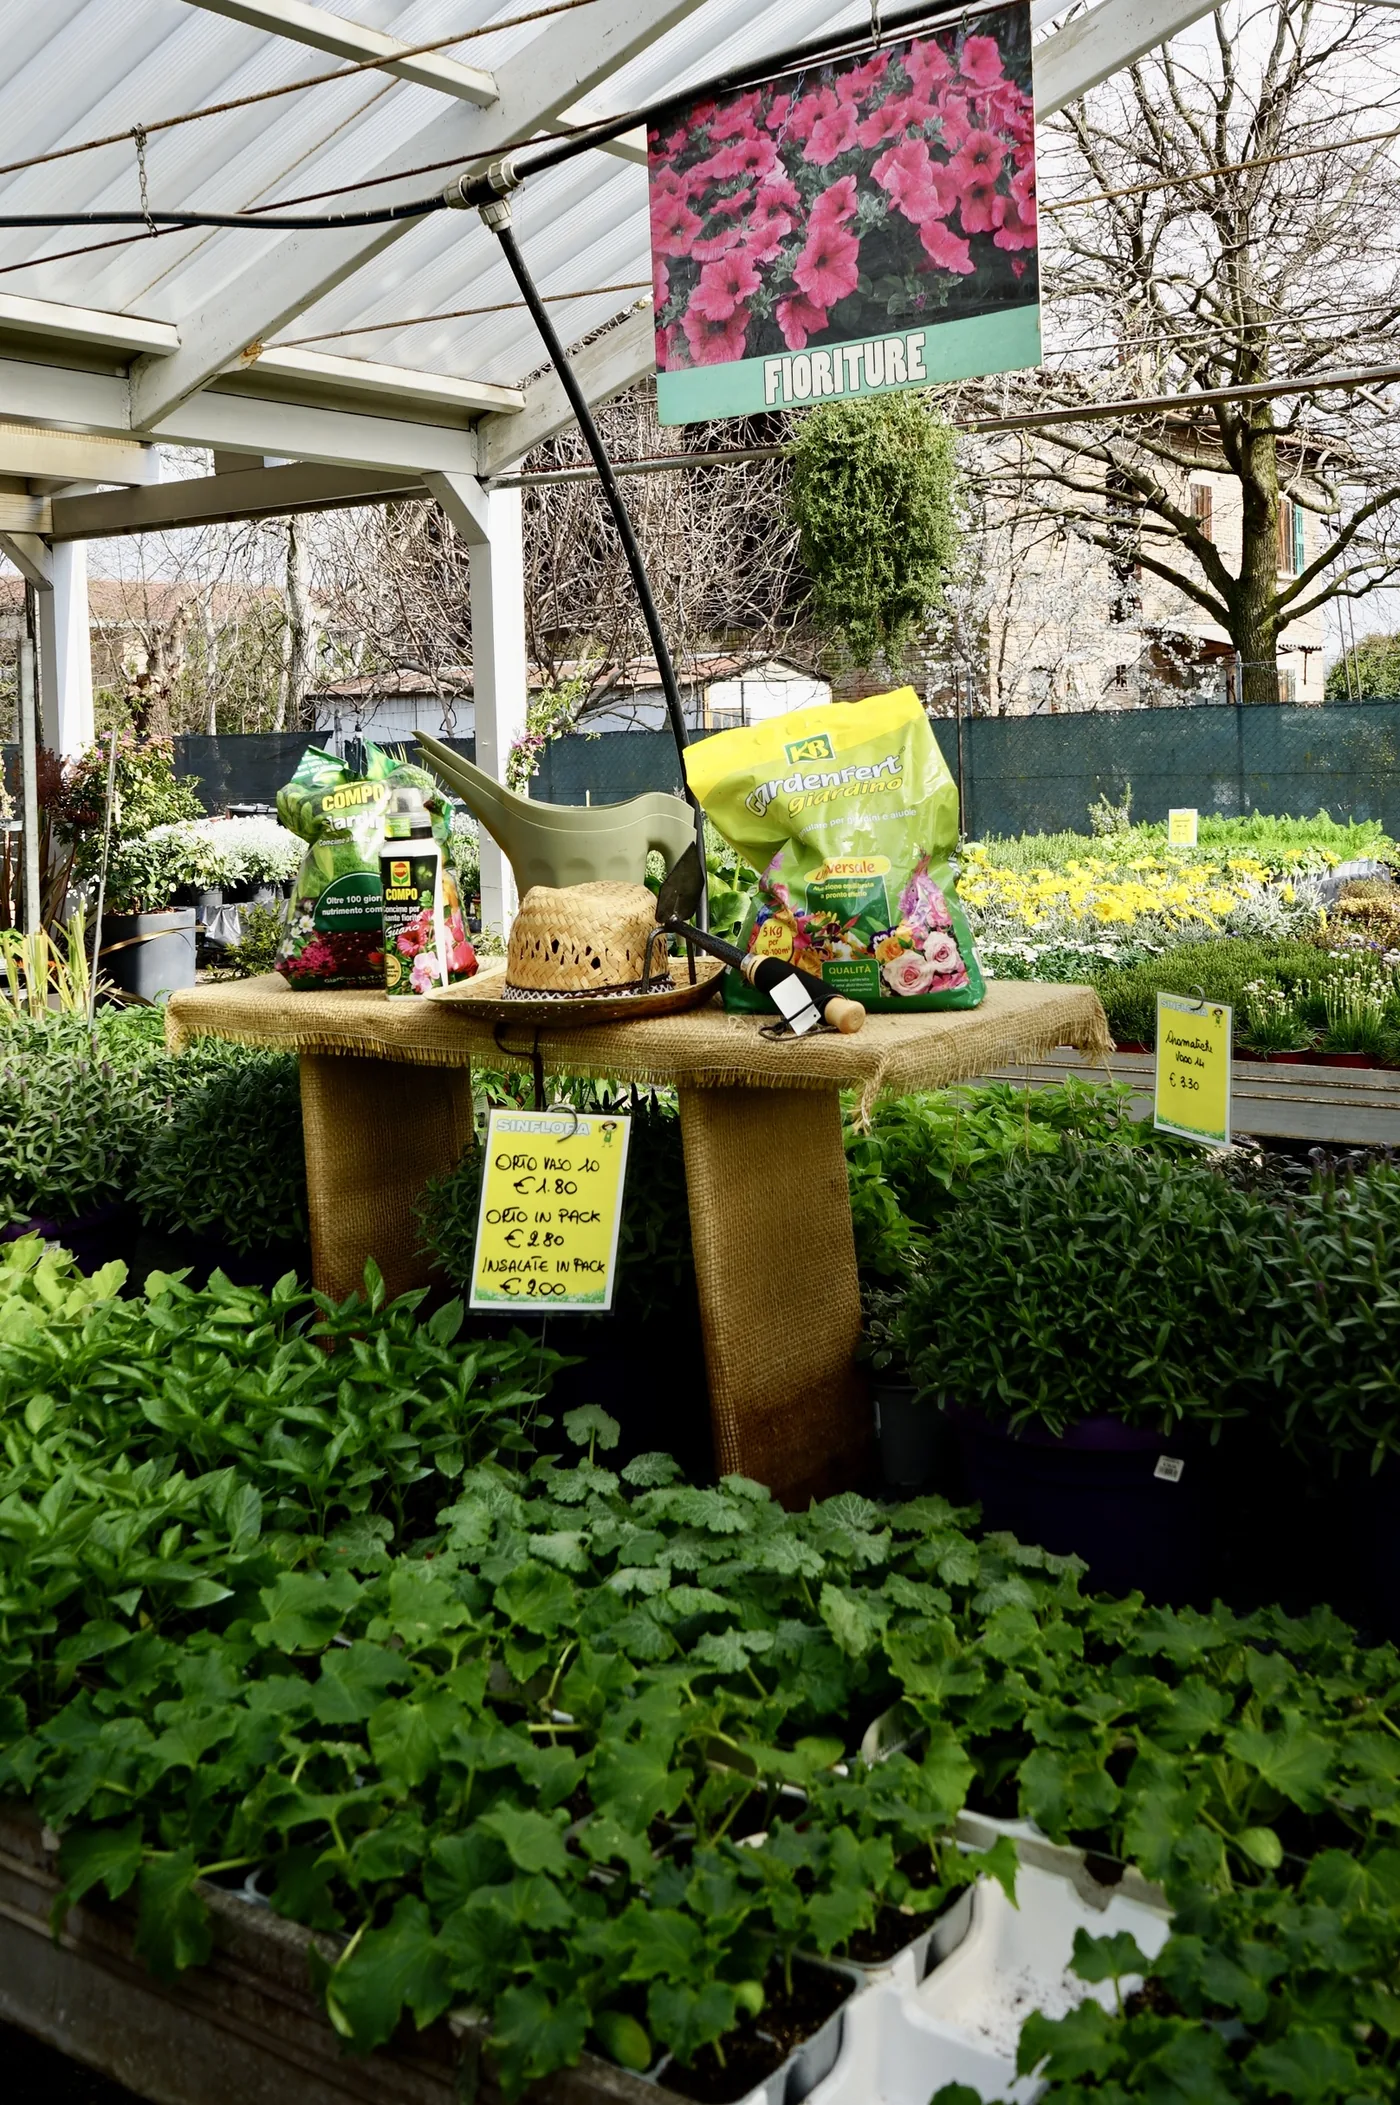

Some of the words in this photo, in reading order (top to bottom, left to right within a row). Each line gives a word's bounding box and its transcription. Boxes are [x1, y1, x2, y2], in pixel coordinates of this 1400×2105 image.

[764, 332, 926, 405] FIORITURE
[790, 739, 829, 763] KB
[322, 783, 385, 812] COMPO
[788, 777, 903, 819] giardino
[830, 817, 845, 827] per
[326, 897, 344, 905] Oltre
[346, 895, 362, 903] 100
[385, 888, 418, 901] COMPO
[322, 906, 363, 916] nutrimento
[384, 905, 408, 913] oncime
[409, 906, 420, 914] per
[385, 924, 420, 938] Guano
[762, 927, 768, 936] 5
[769, 926, 783, 937] Kg
[768, 939, 779, 949] per
[828, 963, 872, 975] QUALITÀ
[495, 1118, 591, 1136] SINFLORA
[495, 1153, 538, 1171] ORTO
[544, 1156, 572, 1172] VASO
[577, 1157, 600, 1172] 10
[486, 1206, 528, 1224] ORTO
[534, 1211, 552, 1223] IN
[558, 1208, 601, 1225] PACK
[482, 1255, 549, 1273] INSALATE
[556, 1260, 570, 1273] IN
[573, 1257, 605, 1274] PACK
